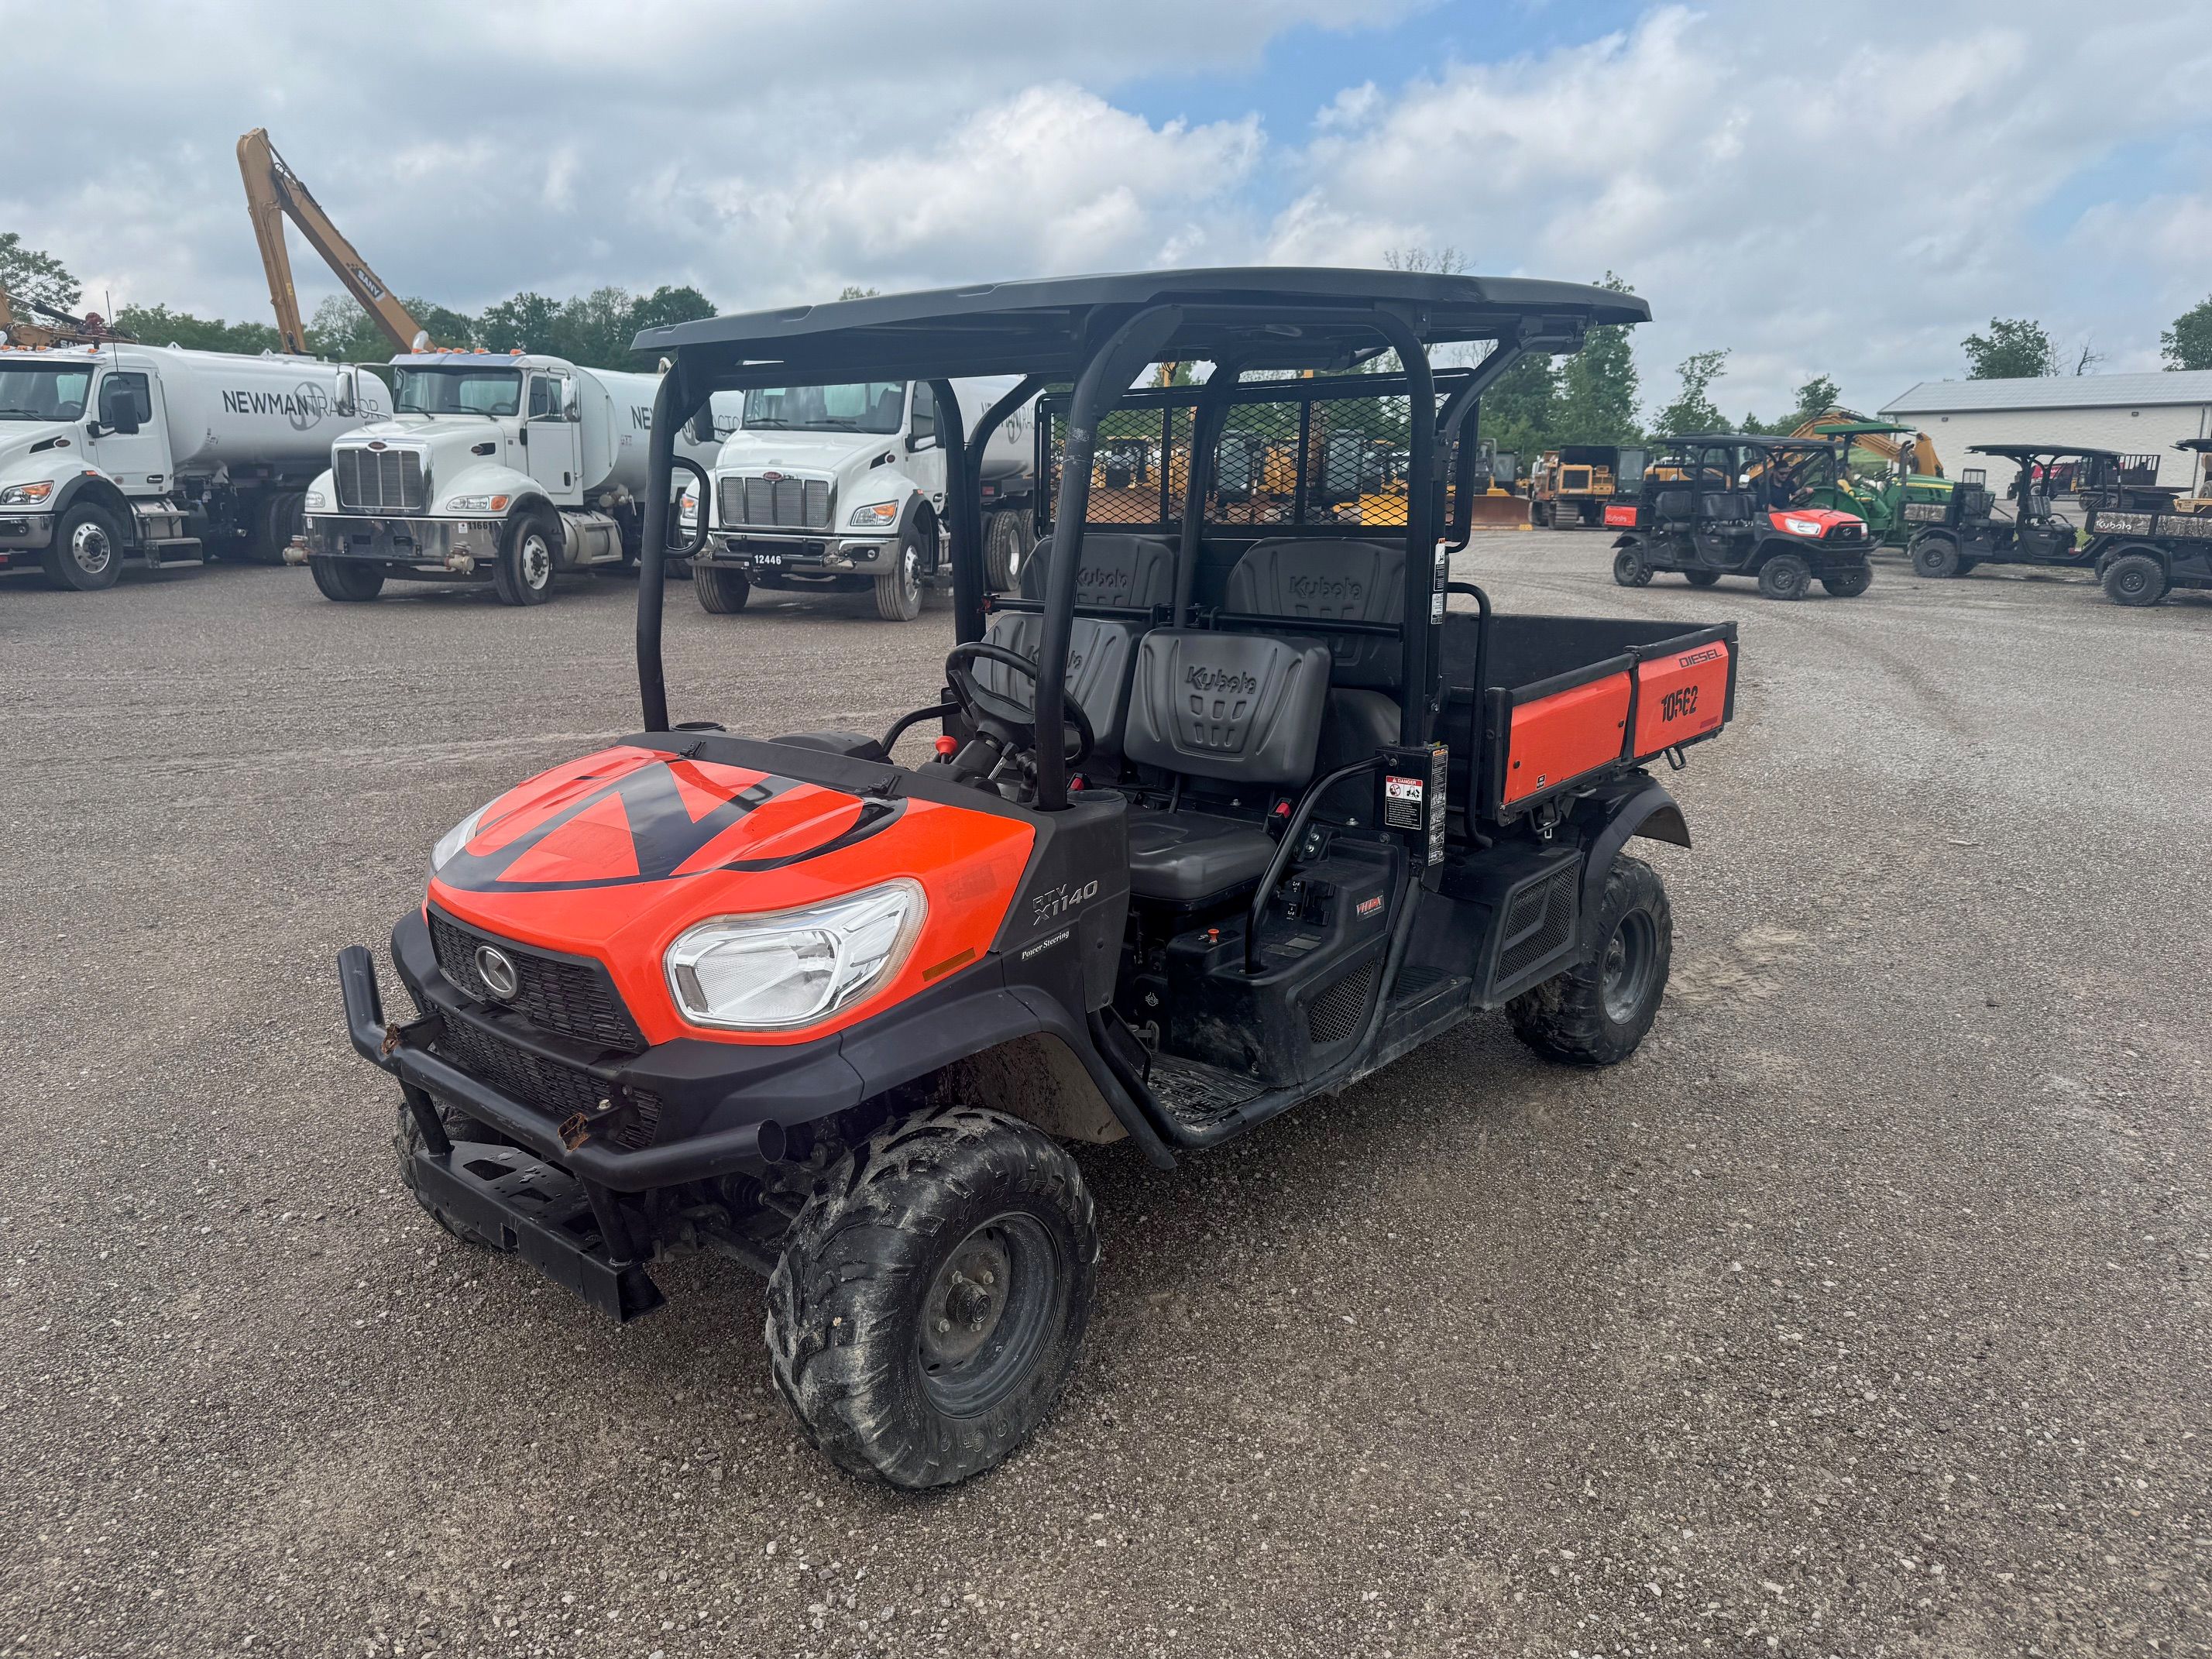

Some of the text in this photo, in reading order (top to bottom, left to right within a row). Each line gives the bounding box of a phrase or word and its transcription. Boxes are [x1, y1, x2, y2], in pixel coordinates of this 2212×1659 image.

[2096, 520, 2131, 530] Kubota
[754, 555, 782, 565] 12446
[1288, 576, 1363, 600] Kubota
[1678, 648, 1723, 668] DIESEL
[1183, 665, 1257, 695] Kubota
[1032, 884, 1067, 909] RTV
[1033, 880, 1098, 926] X1140
[1022, 931, 1070, 960] Power Steering
